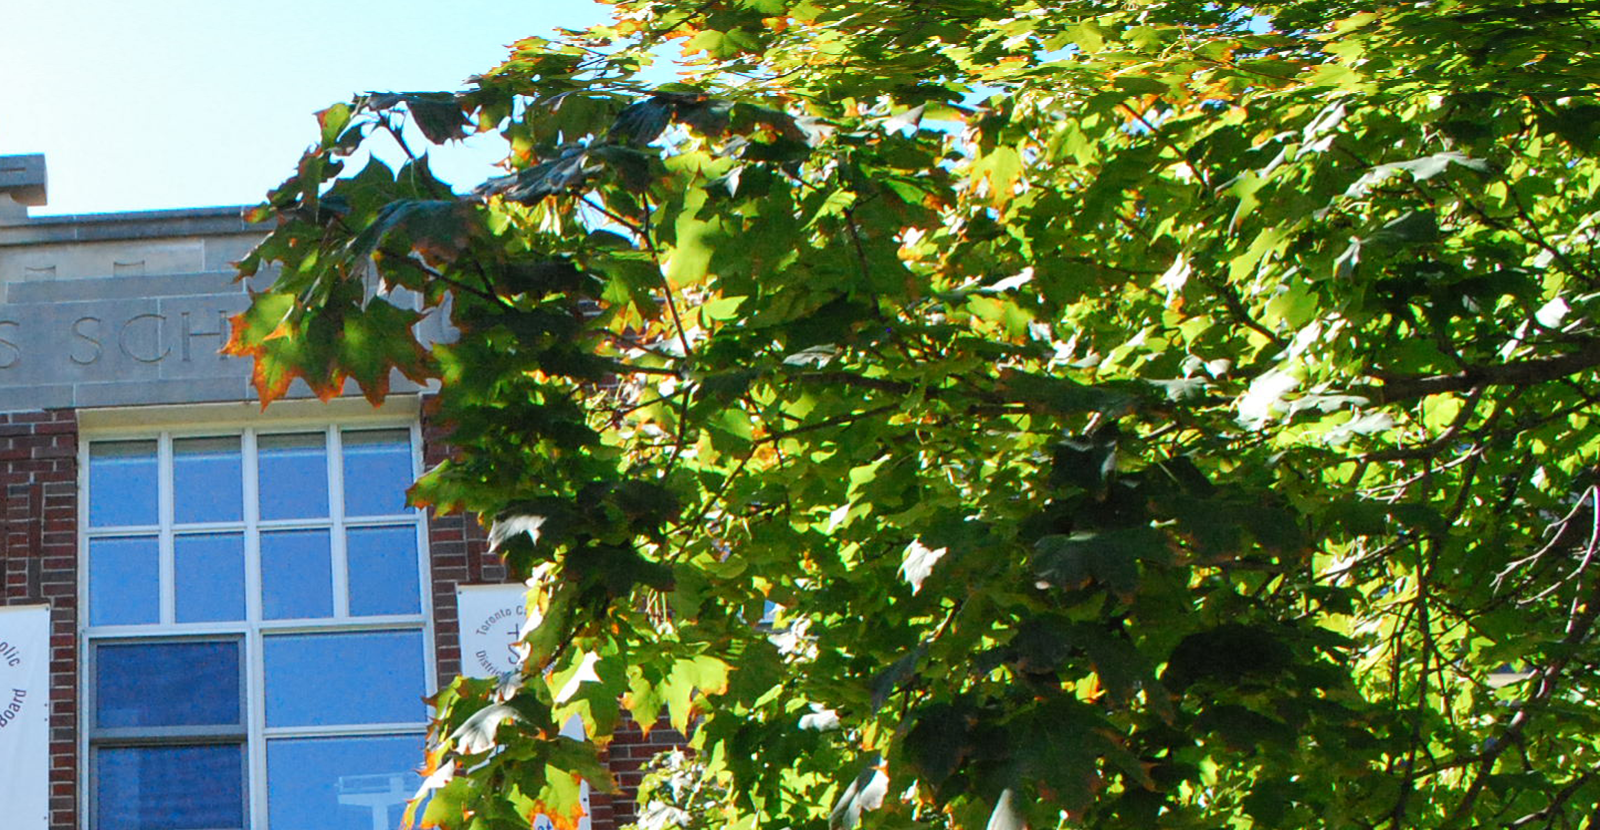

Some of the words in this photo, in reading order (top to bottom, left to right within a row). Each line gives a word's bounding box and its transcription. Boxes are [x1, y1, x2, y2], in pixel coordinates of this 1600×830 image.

[69, 309, 229, 366] SCH
[476, 608, 512, 636] Toronto
[475, 649, 505, 678] Distric
